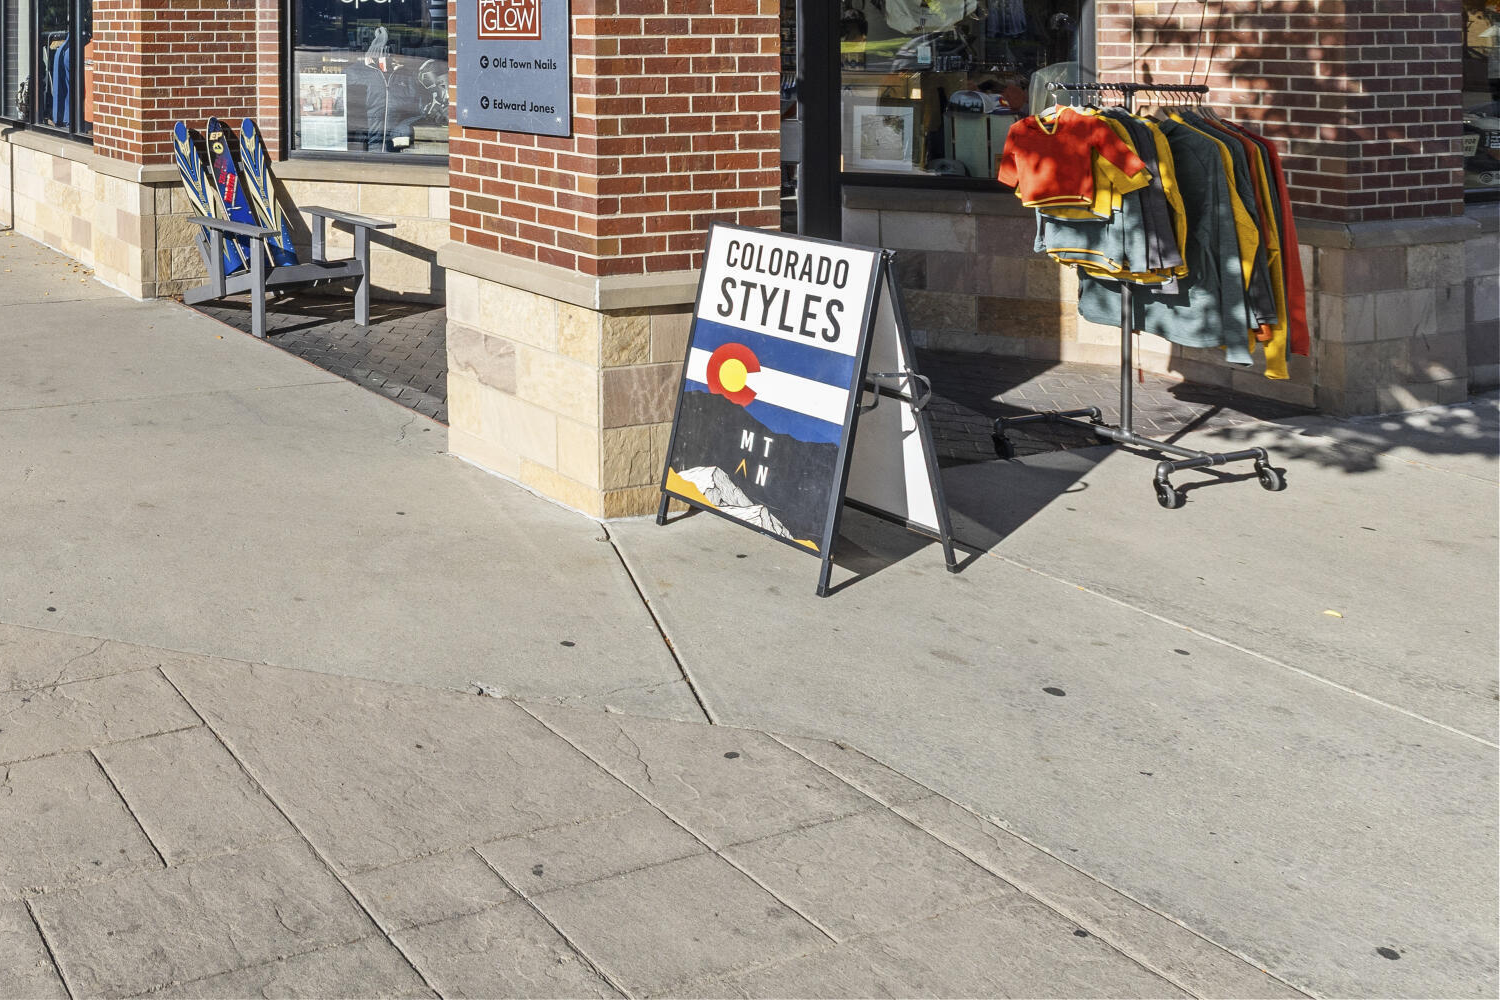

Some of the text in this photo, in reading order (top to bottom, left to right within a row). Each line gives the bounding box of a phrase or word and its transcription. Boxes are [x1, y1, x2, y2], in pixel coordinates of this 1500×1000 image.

[483, 5, 535, 31] GLOW
[492, 57, 557, 70] Old Town Nails
[493, 99, 555, 114] Edward Jones
[726, 240, 850, 289] COLORADO
[717, 276, 845, 343] STYLES
